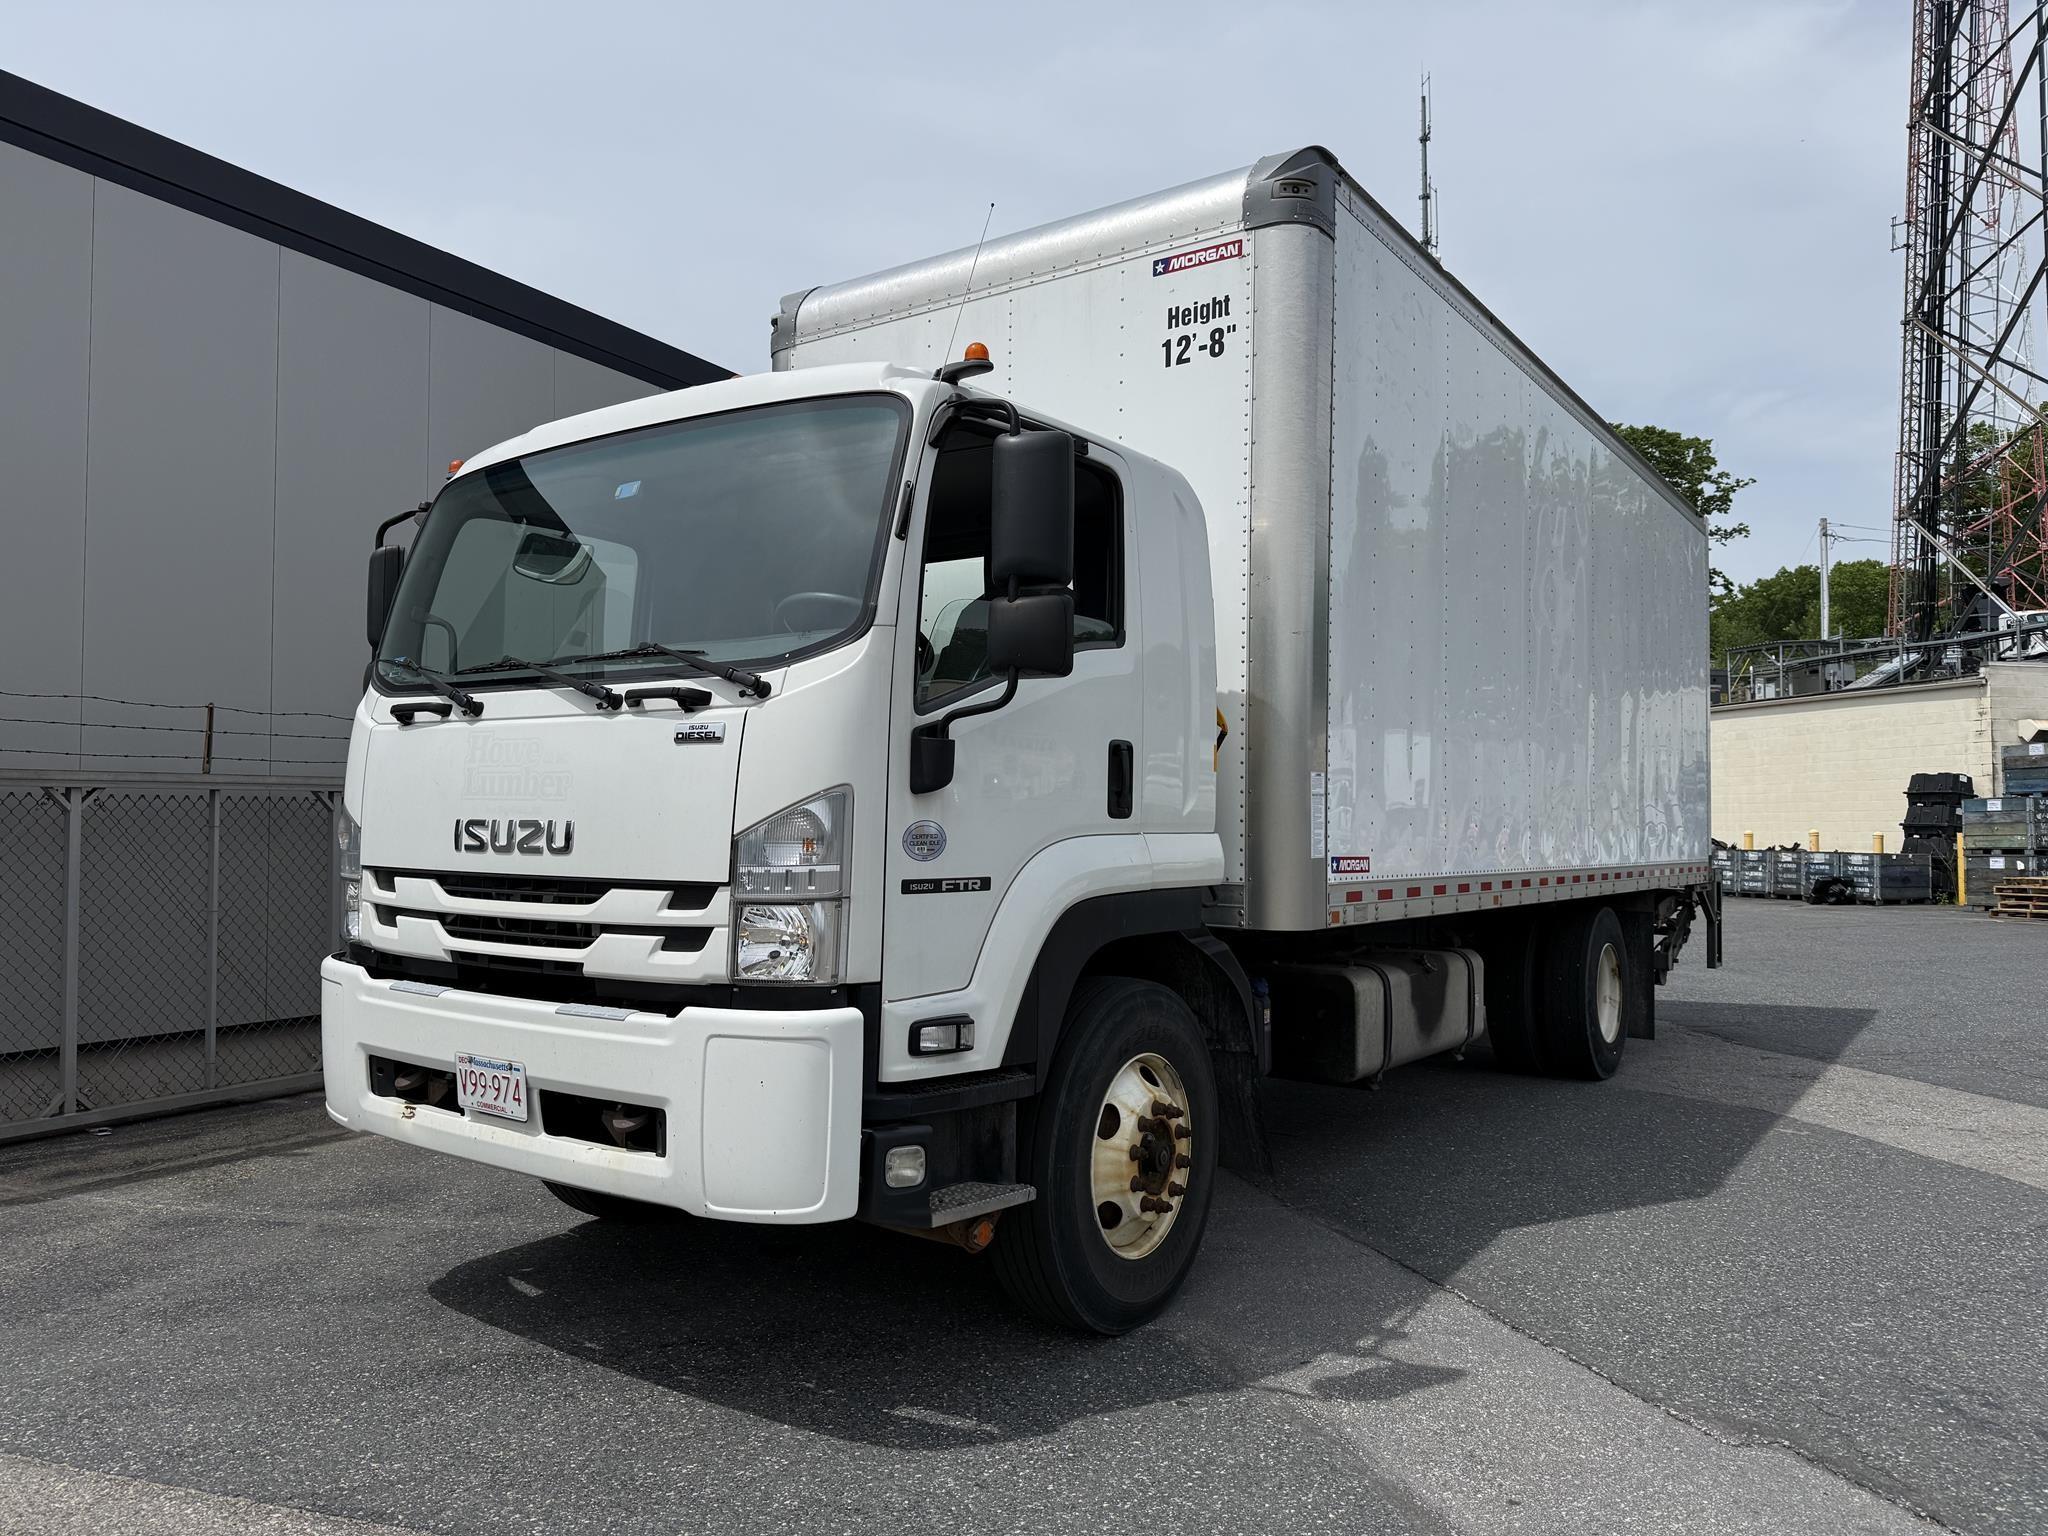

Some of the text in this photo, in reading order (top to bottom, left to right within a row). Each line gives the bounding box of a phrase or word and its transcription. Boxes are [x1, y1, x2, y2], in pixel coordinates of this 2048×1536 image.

[1168, 242, 1239, 271] MORGAN
[1167, 294, 1231, 330] Height
[675, 731, 722, 741] DIESEL
[454, 818, 576, 857] ISUZU
[1338, 859, 1369, 871] MORGAN
[941, 879, 981, 892] FTR
[476, 1100, 508, 1114] COMMERCIAL
